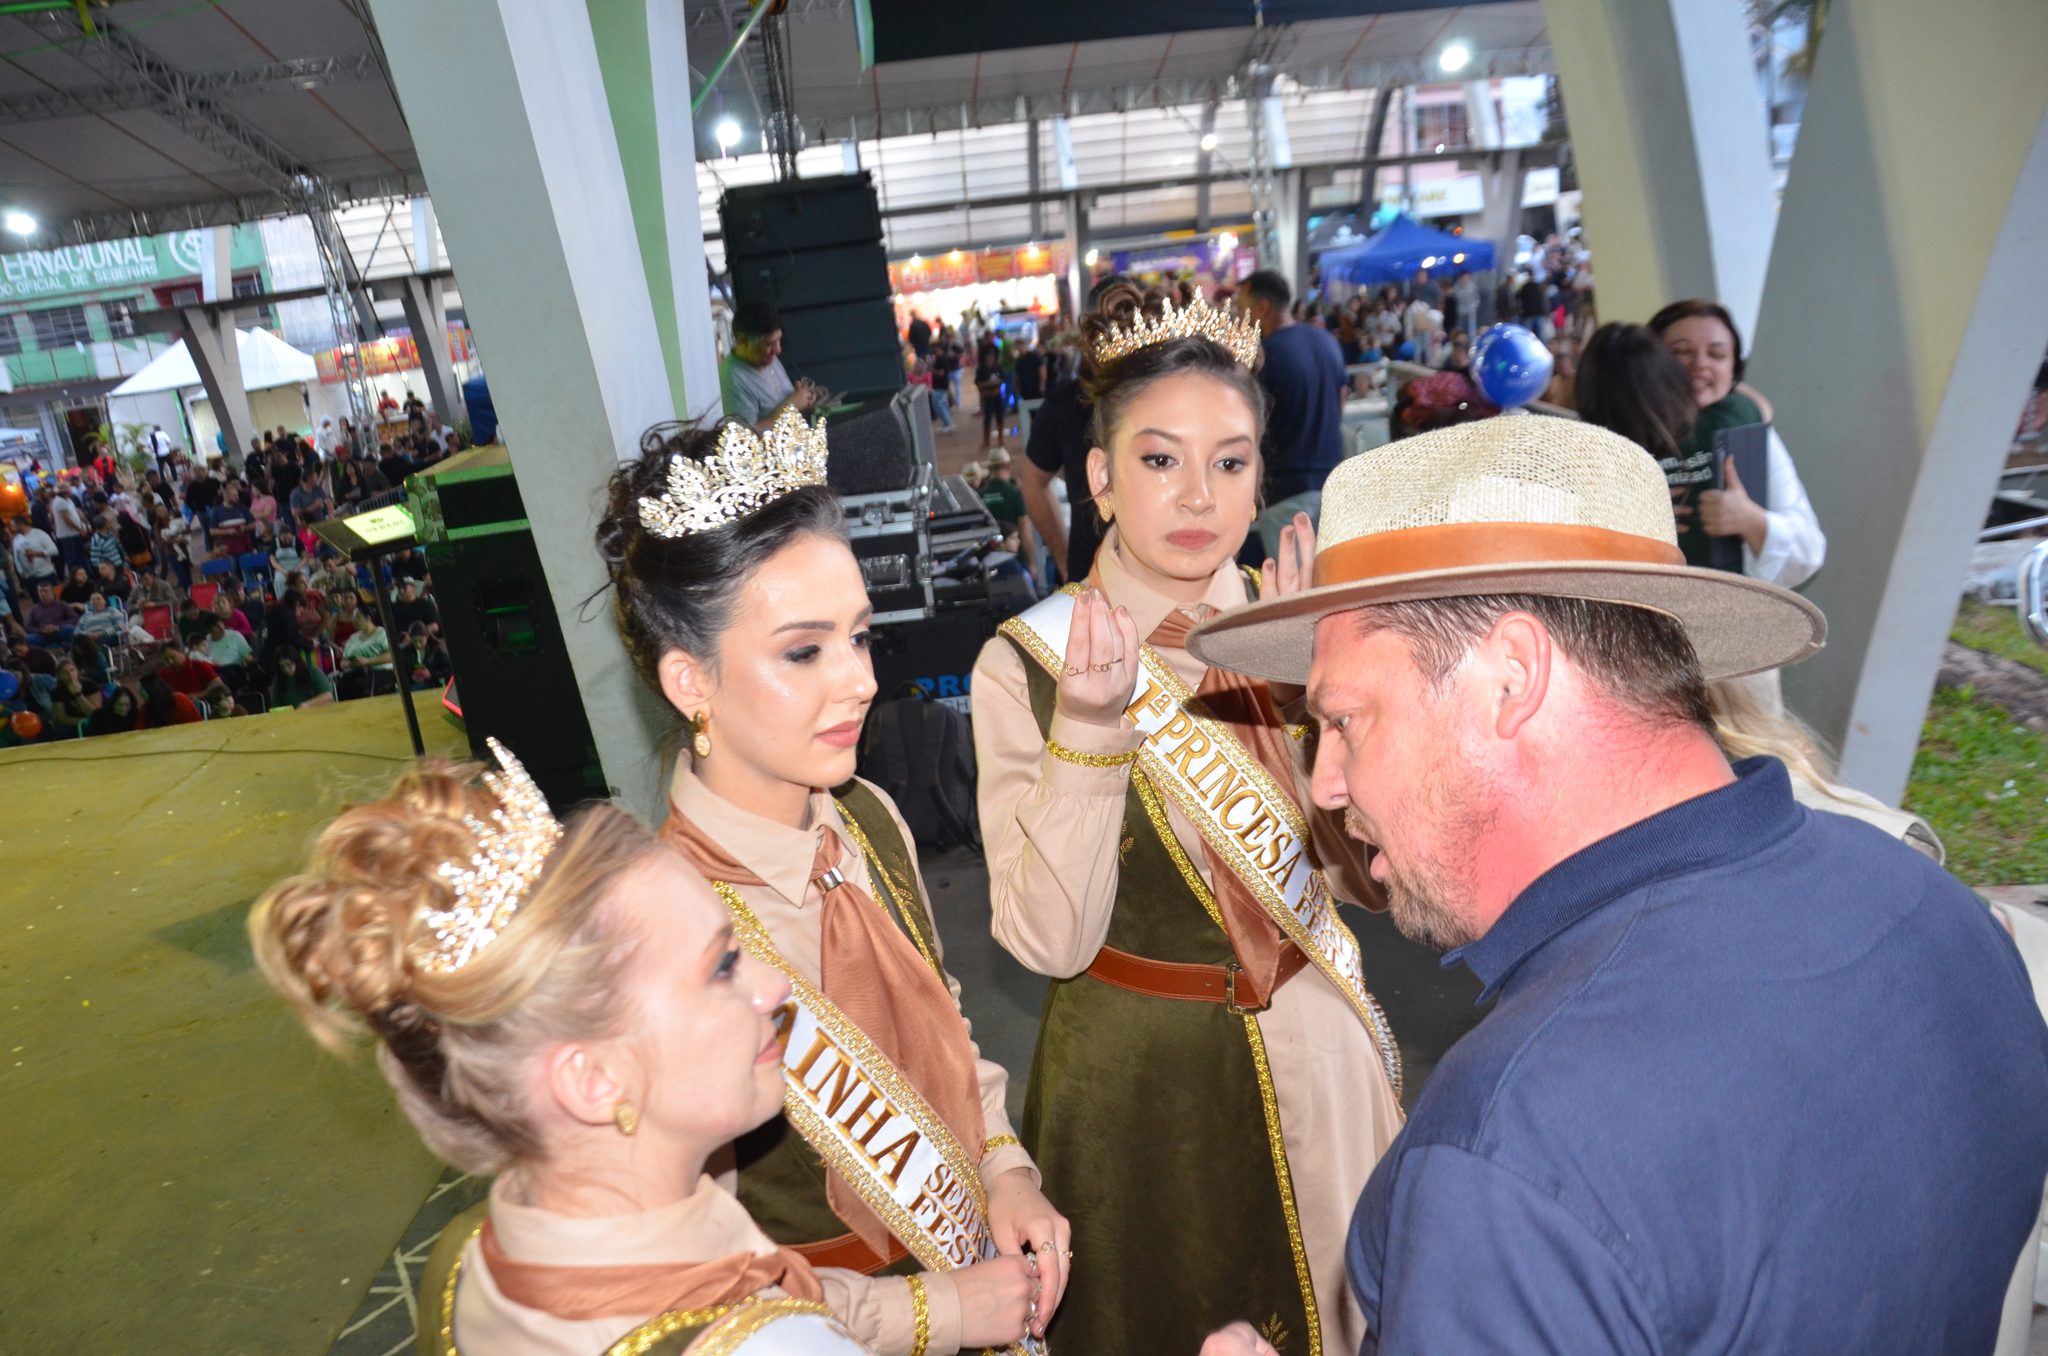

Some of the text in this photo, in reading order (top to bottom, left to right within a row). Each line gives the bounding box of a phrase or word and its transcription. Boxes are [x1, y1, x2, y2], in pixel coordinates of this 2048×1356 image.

[0, 237, 156, 282] ERNACIONAL
[17, 277, 67, 294] OFICIAL
[70, 271, 89, 288] DE
[1148, 707, 1302, 895] PRINCESA
